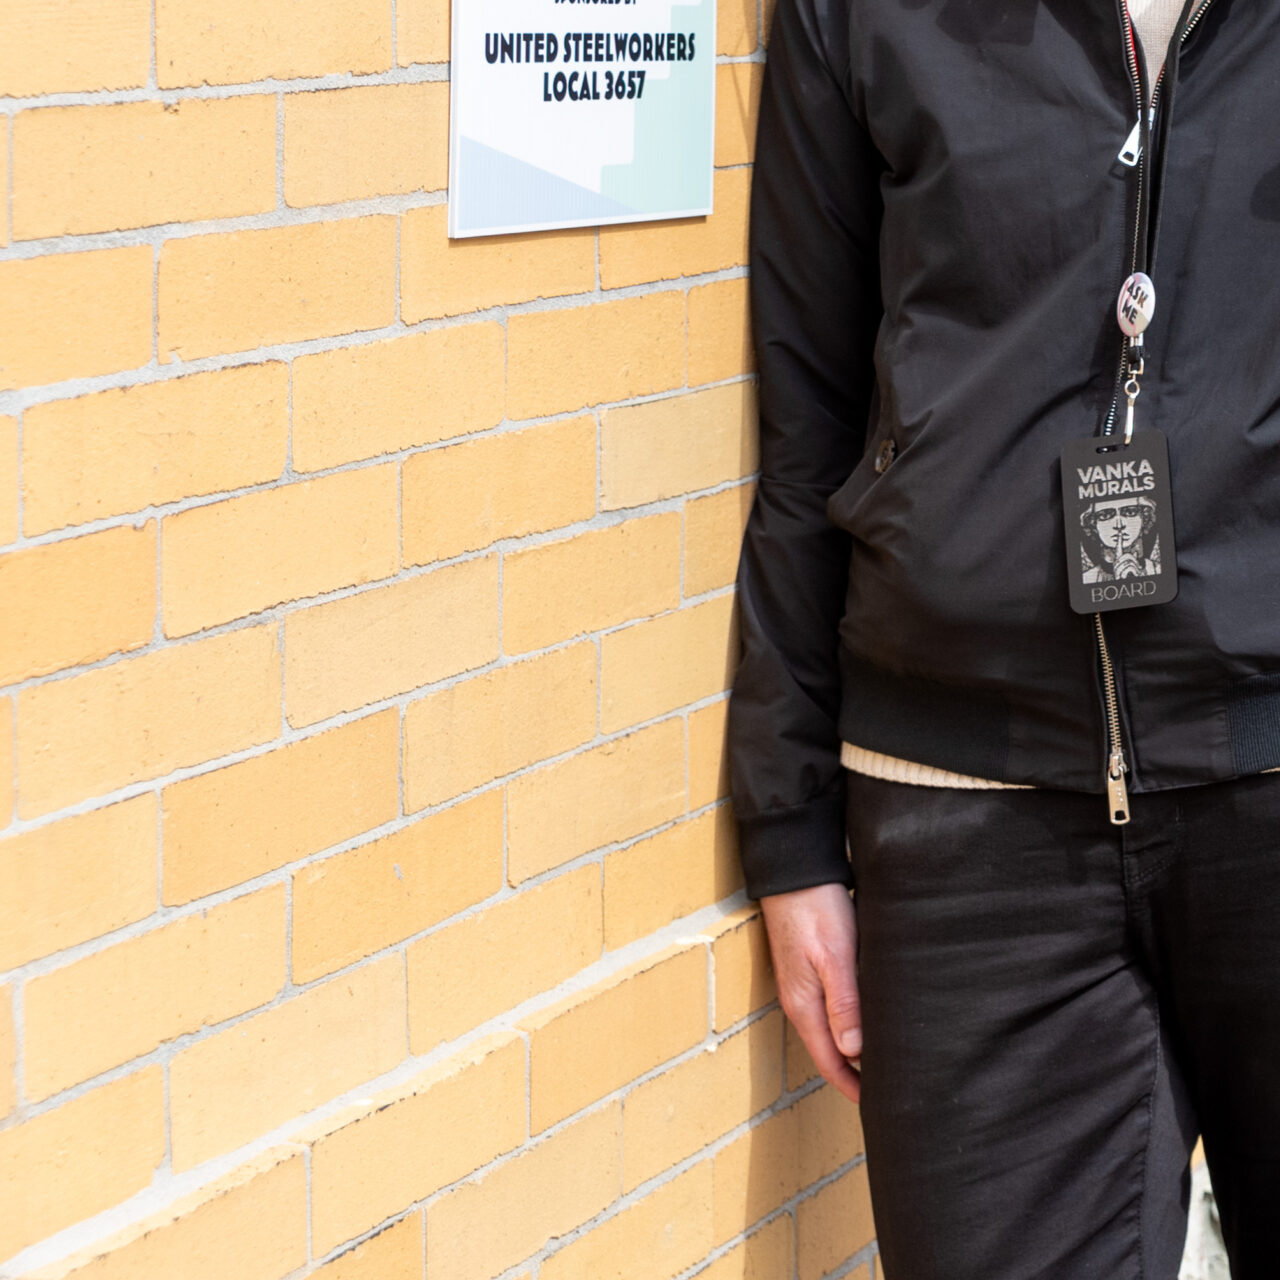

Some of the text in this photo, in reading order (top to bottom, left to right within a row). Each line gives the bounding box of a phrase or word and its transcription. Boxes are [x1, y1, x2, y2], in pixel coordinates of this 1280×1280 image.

[484, 32, 696, 64] UNITED STEELWORKERS
[543, 71, 646, 102] LOCAL 3657
[1126, 280, 1149, 308] ASK
[1121, 298, 1138, 324] ME
[1077, 459, 1154, 483] VANKA
[1078, 476, 1156, 499] MURALS
[1091, 580, 1157, 603] BOARD
